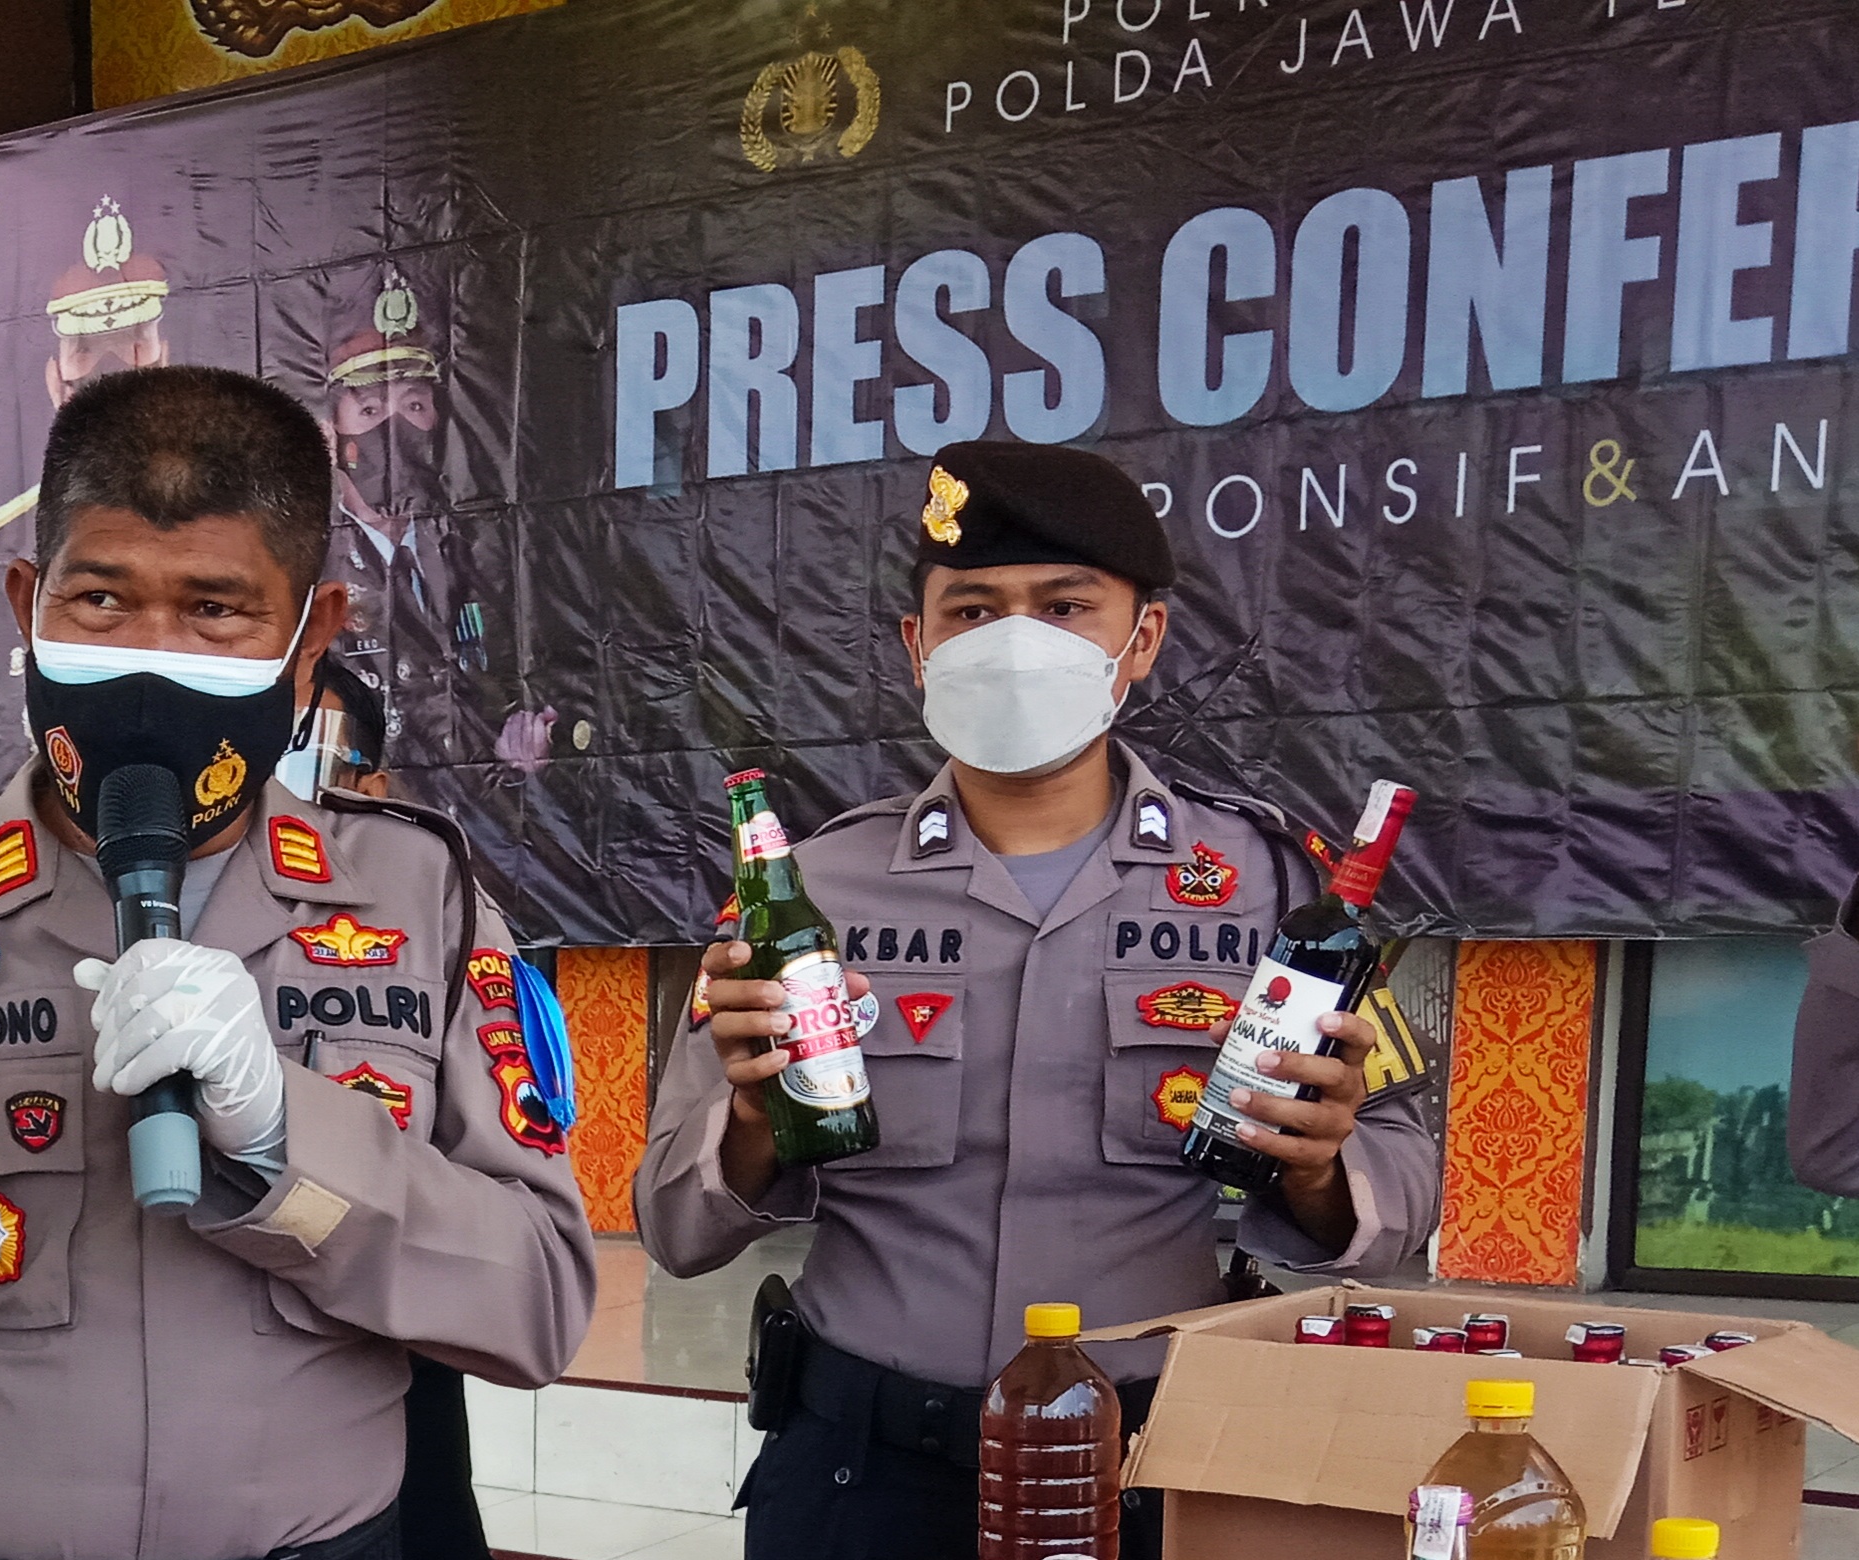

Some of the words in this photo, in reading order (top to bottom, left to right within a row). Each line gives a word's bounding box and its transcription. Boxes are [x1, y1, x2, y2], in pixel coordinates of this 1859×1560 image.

[945, 38, 1214, 133] POLDA
[1279, 0, 1522, 75] JAWA
[615, 231, 1106, 490] PRESS
[1581, 438, 1638, 508] &
[845, 925, 963, 964] KBAR
[1115, 920, 1259, 968] POLRI
[276, 984, 432, 1039] POLRI
